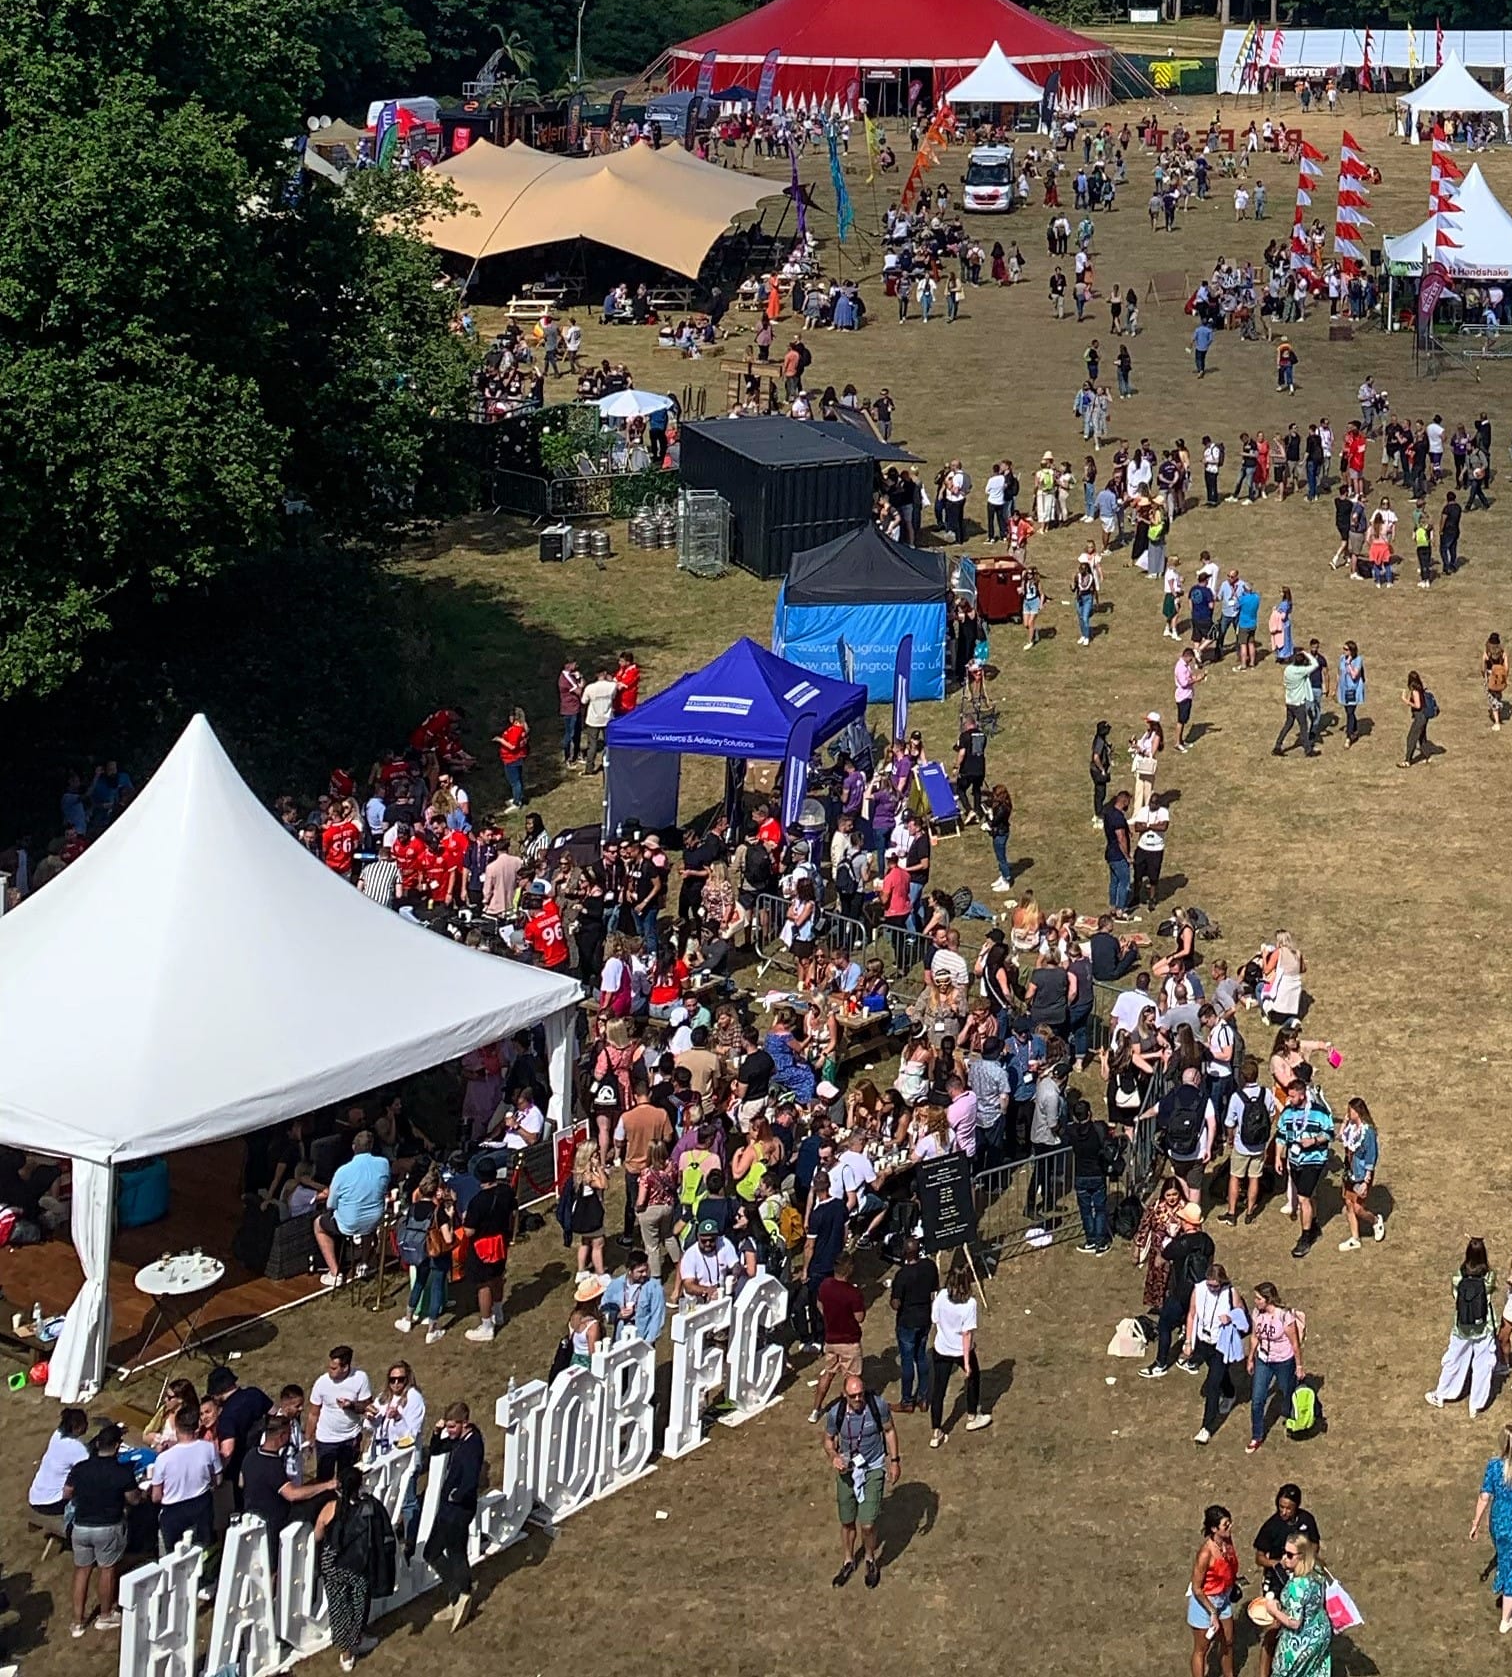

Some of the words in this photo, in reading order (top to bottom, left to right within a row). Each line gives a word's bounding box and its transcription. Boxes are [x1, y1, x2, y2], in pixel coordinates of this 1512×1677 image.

[1285, 67, 1327, 77] RECFEST
[1457, 267, 1509, 277] Handshake
[651, 733, 686, 743] Workforce
[687, 735, 693, 743] &
[694, 735, 723, 747] Advisory
[724, 738, 755, 748] Solutions
[541, 921, 564, 946] 96
